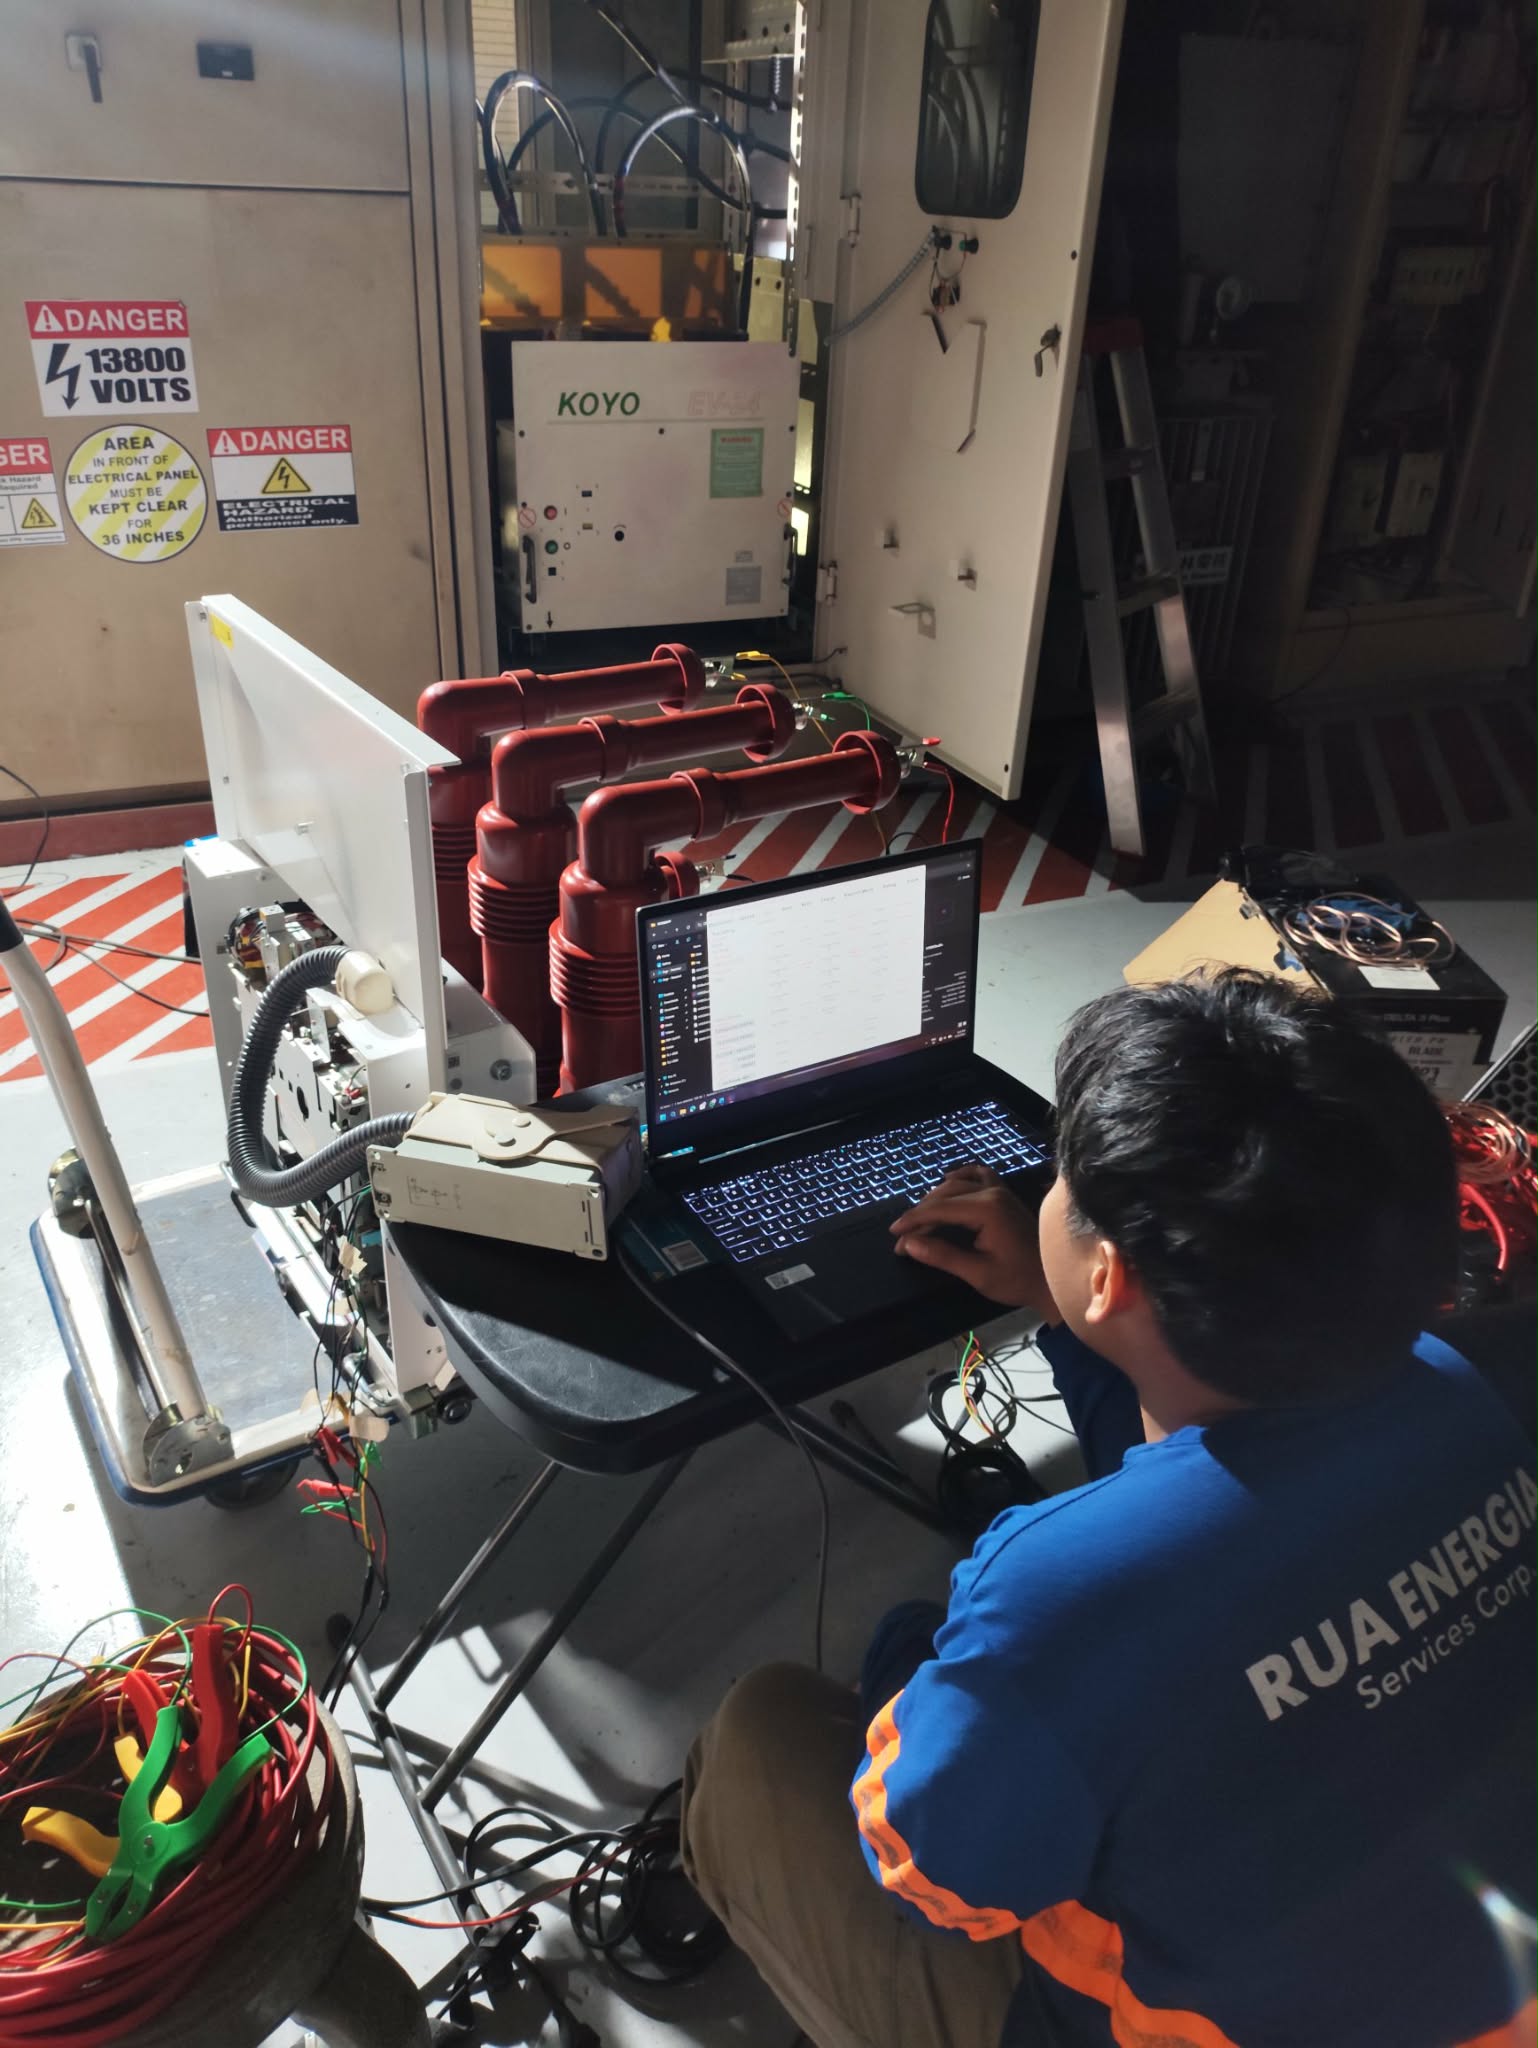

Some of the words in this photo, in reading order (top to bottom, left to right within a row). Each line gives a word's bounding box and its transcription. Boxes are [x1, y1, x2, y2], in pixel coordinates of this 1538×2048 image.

[65, 308, 186, 332] DANGER
[85, 347, 187, 374] 13800
[90, 377, 192, 404] VOLTS
[557, 391, 641, 416] KOYO
[104, 436, 155, 451] AREA
[240, 428, 348, 451] DANGER
[93, 457, 105, 467] IN
[109, 456, 149, 467] FRONT
[153, 455, 169, 465] OF
[68, 471, 152, 485] ELECTRICAL
[156, 469, 199, 481] PANEL
[110, 488, 143, 498] MUST
[147, 486, 163, 497] BE
[89, 502, 131, 515] KEPT
[136, 500, 189, 513] CLEAR
[222, 498, 351, 510] ELECTRICAL
[127, 518, 153, 529] FOR
[225, 513, 313, 523] Authorized
[226, 519, 307, 530] personnel
[102, 534, 121, 546] 36
[126, 531, 185, 545] INCHES
[1245, 1598, 1401, 1722] RUA
[1387, 1466, 1538, 1631] ENERGIA
[1356, 1613, 1477, 1710] Services
[1476, 1564, 1538, 1619] Corp.
